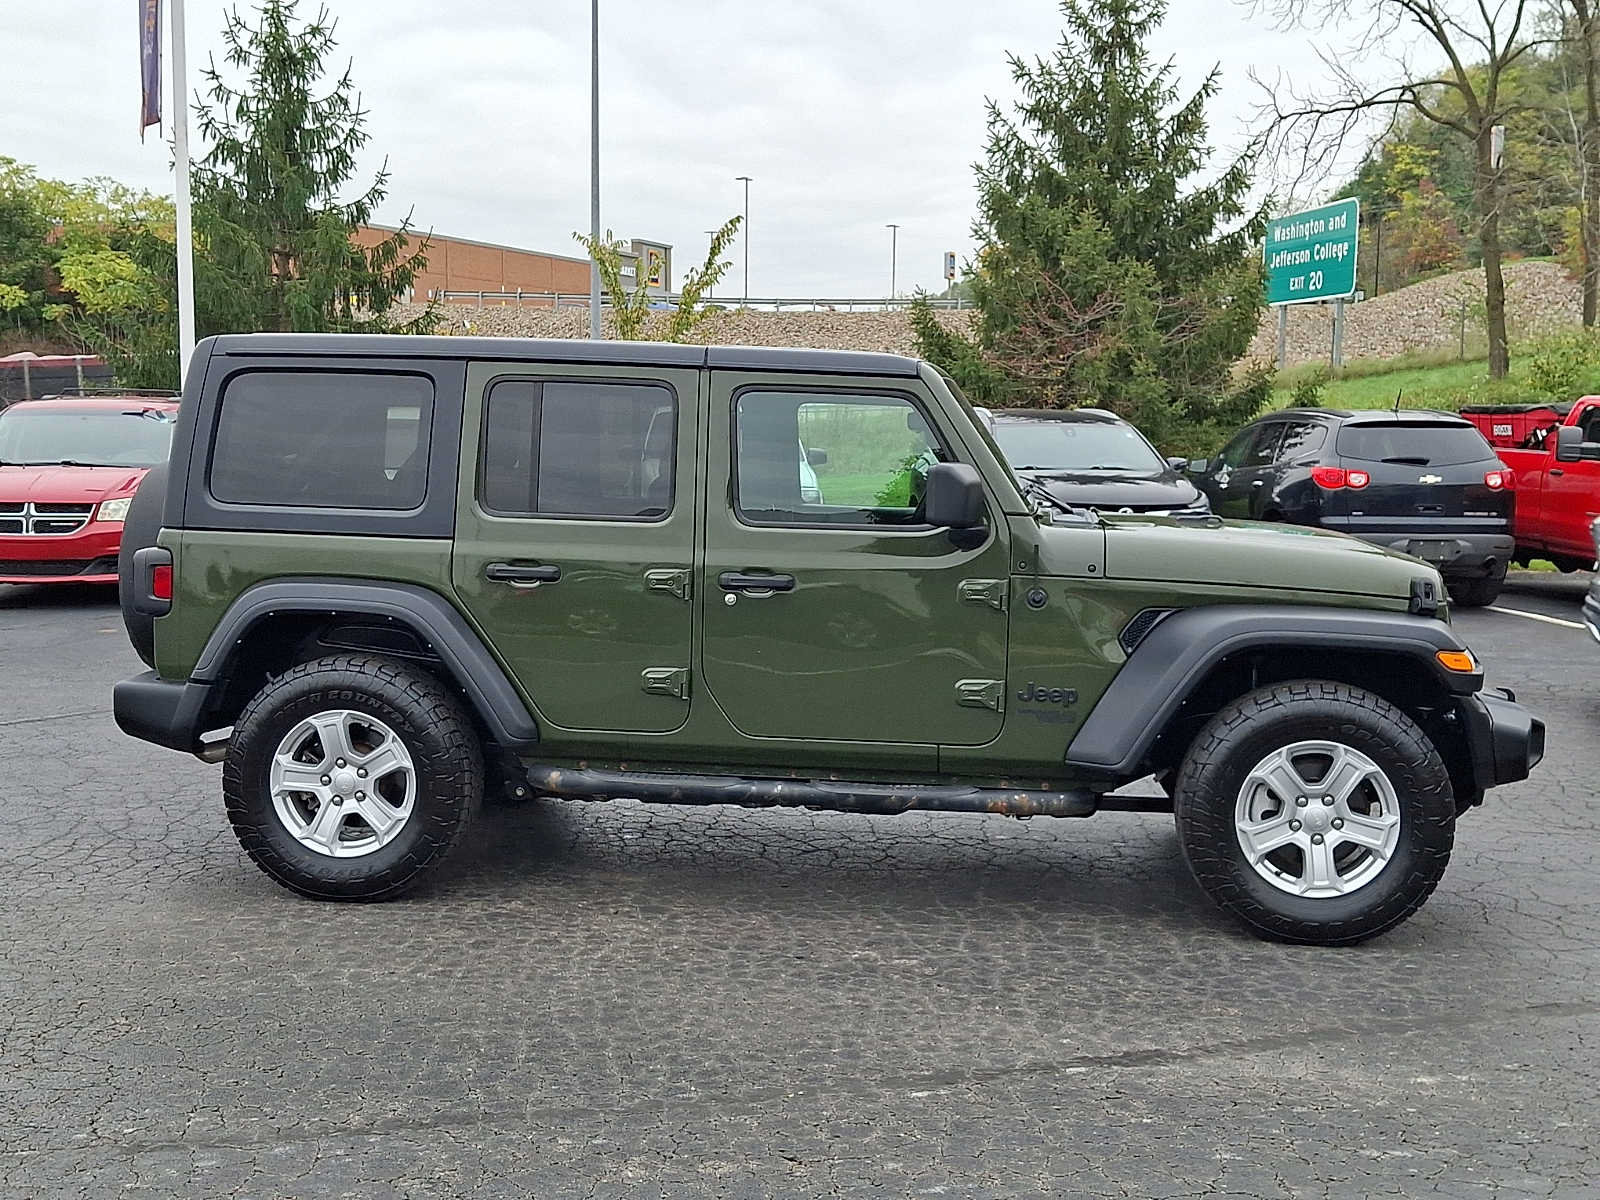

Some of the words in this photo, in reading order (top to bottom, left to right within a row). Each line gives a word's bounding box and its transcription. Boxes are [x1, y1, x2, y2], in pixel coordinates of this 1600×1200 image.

[1274, 219, 1325, 242] Washington
[1328, 211, 1347, 230] and
[1270, 249, 1311, 269] Jefferson
[1313, 241, 1349, 262] College
[1289, 275, 1305, 291] EXIT
[1308, 270, 1323, 291] 20
[1017, 681, 1078, 707] Jeep
